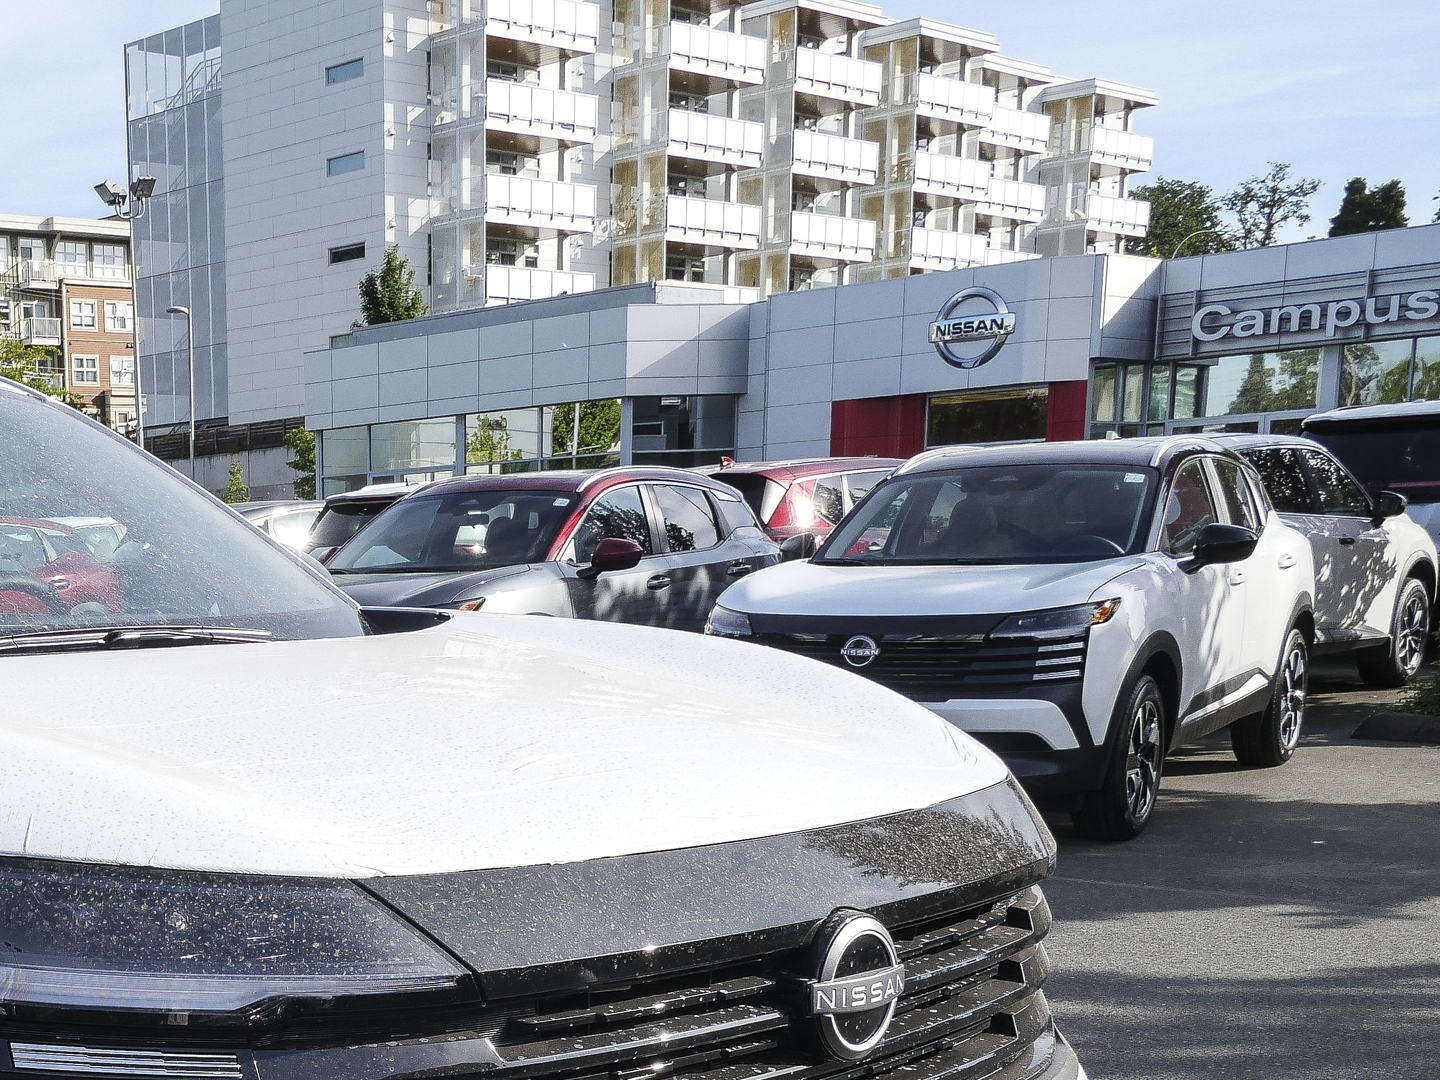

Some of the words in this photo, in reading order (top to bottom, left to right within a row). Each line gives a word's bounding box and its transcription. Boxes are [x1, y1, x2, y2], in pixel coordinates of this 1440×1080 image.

[935, 317, 1005, 338] NISSAN
[1191, 290, 1440, 341] Campus
[840, 648, 880, 656] NISSAN
[816, 974, 905, 1010] NISSAN
